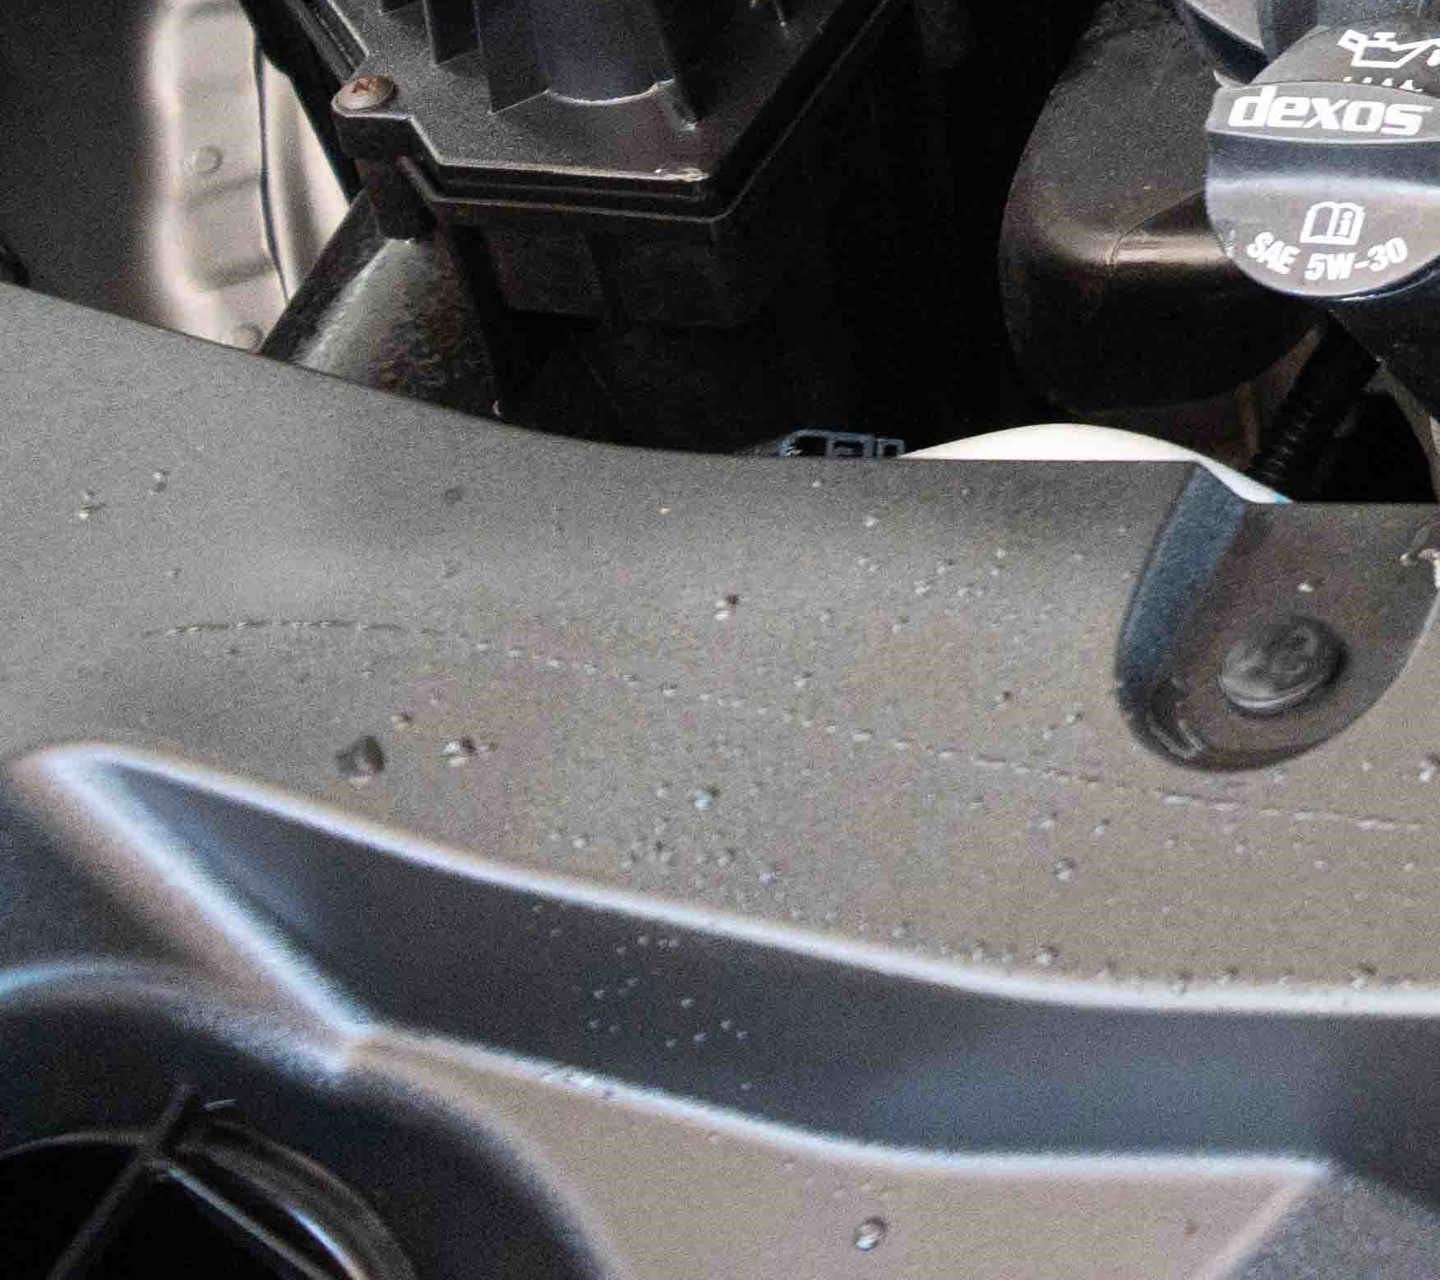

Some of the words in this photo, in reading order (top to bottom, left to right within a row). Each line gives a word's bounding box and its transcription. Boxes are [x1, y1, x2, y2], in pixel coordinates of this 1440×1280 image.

[1228, 86, 1434, 136] dexos
[1247, 232, 1300, 275] SAE
[1304, 237, 1408, 281] 5W-30
